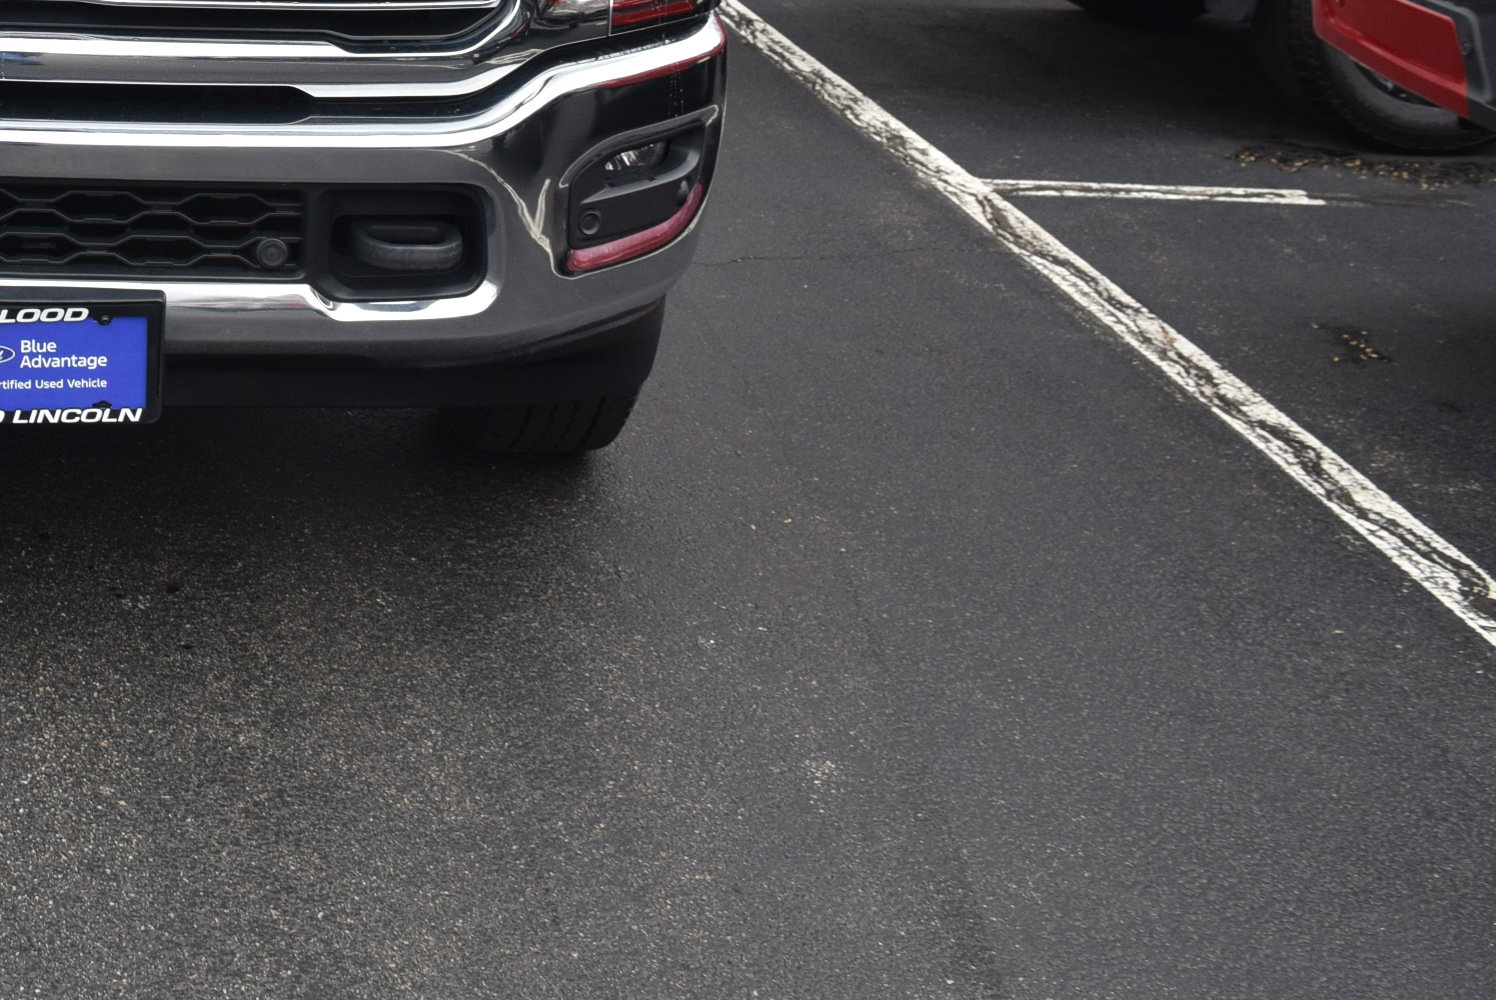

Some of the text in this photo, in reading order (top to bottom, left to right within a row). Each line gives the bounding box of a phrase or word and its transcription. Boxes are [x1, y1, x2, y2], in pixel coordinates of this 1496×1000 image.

[20, 339, 57, 353] Blue
[20, 355, 108, 370] Advantage
[35, 379, 64, 389] Used
[67, 378, 108, 388] Vehicle
[12, 408, 143, 425] LINCOLN
